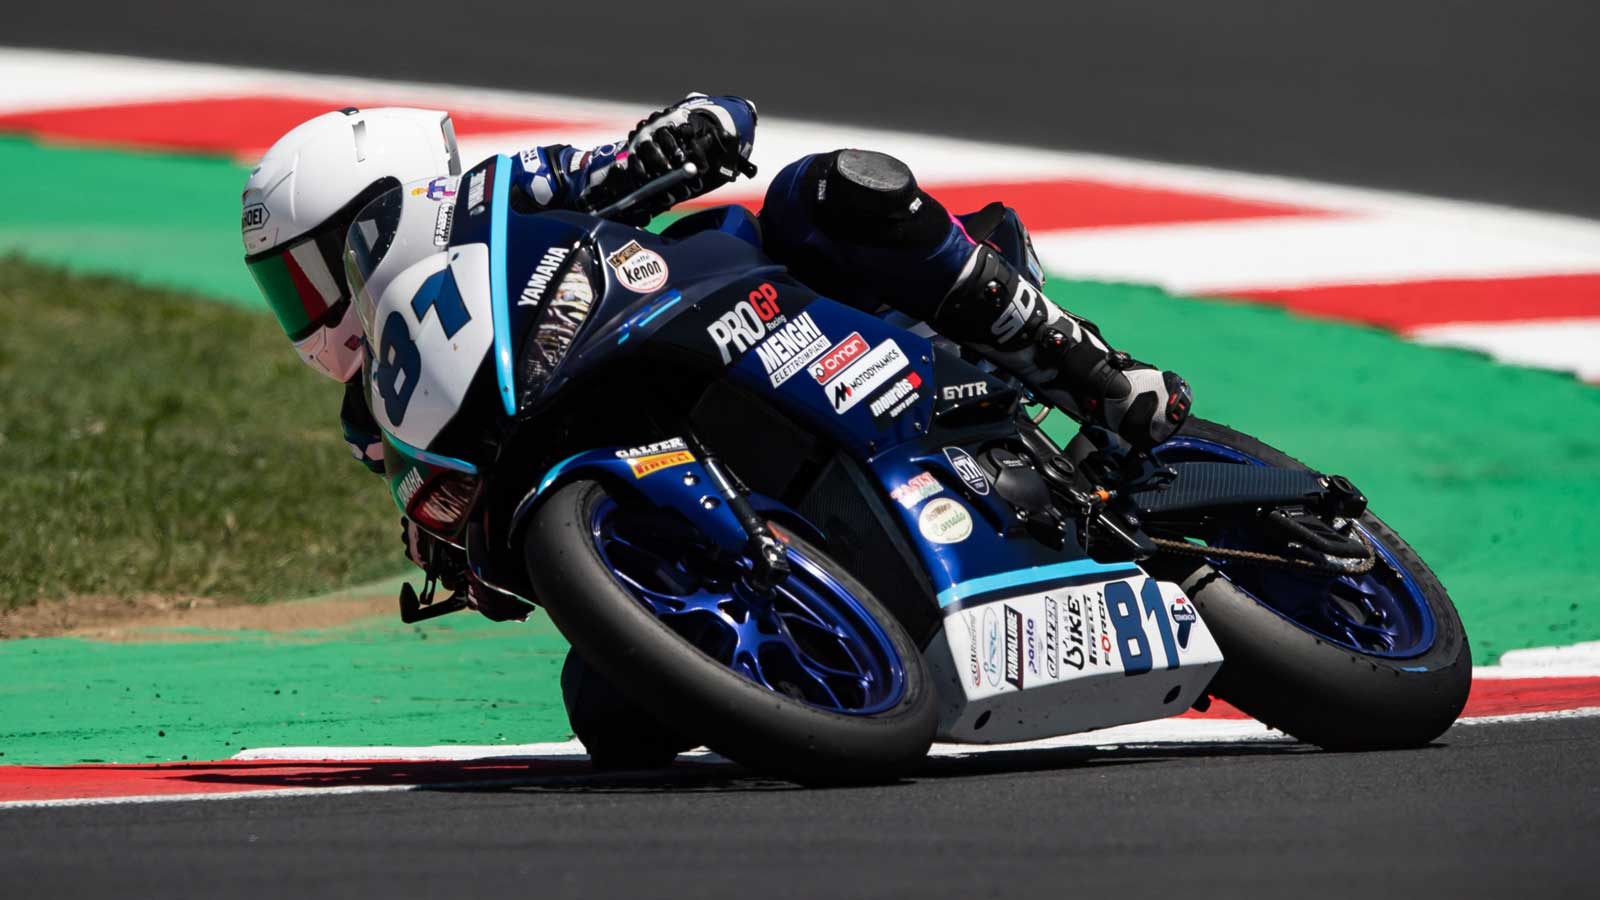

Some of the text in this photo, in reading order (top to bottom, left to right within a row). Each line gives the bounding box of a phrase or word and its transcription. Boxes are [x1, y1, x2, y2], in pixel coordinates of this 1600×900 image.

[517, 246, 570, 307] YAMAHA
[622, 261, 663, 285] kenon
[376, 263, 473, 428] 81
[755, 311, 823, 375] MENGHI
[766, 313, 787, 331] Racing
[774, 338, 828, 386] ELETTROIMPIANTI
[824, 340, 862, 372] omar
[850, 348, 901, 391] MOTODYNAMICS
[943, 380, 989, 401] GYTR
[1004, 609, 1019, 678] YAMALUBE
[1103, 576, 1181, 677] 81
